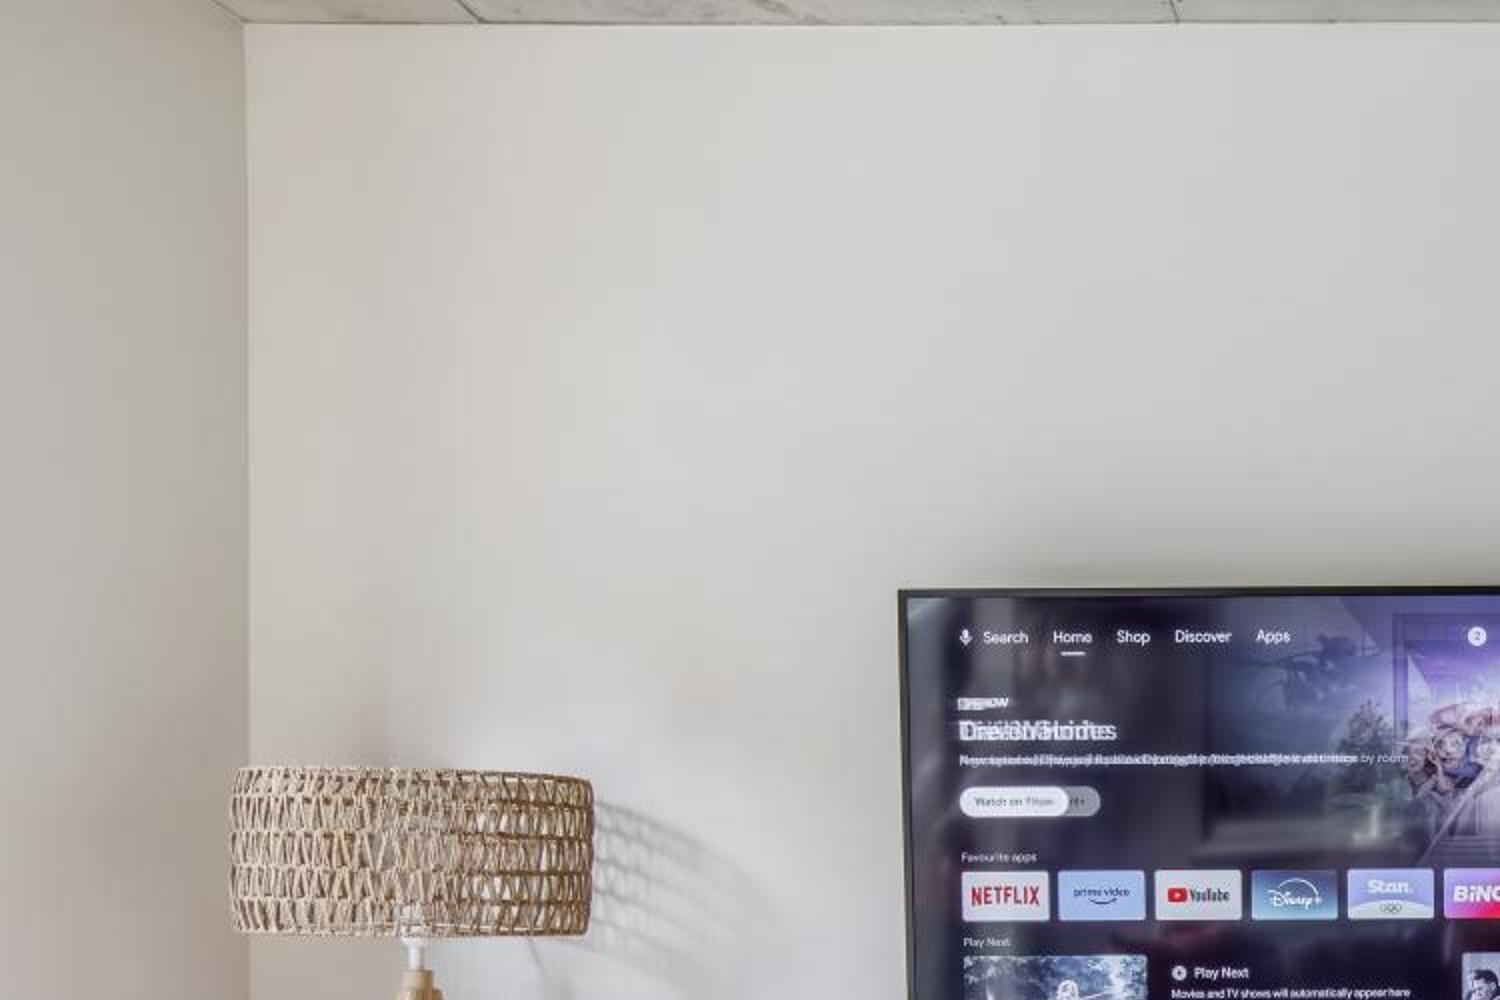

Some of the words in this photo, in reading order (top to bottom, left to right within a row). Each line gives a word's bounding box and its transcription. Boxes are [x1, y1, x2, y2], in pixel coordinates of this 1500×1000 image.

[983, 630, 1030, 645] Search
[1052, 629, 1093, 645] Home
[1116, 628, 1151, 645] Shop
[1174, 628, 1233, 644] Discover
[1255, 628, 1291, 644] Apps
[961, 851, 1010, 863] Favourite
[1011, 853, 1037, 864] apps
[971, 886, 1040, 906] NETFLIX
[1073, 888, 1102, 898] prime
[1103, 887, 1131, 897] video
[1190, 887, 1230, 902] YouTube
[963, 937, 984, 949] Play
[1194, 965, 1219, 981] Play
[1221, 965, 1249, 979] Next
[1171, 988, 1205, 998] Movies
[1207, 988, 1225, 998] and
[1226, 988, 1239, 998] TV
[1241, 988, 1271, 998] shows
[1272, 988, 1288, 998] will
[1290, 988, 1352, 1000] automatically
[1354, 989, 1387, 1000] appear
[1388, 988, 1411, 998] here
